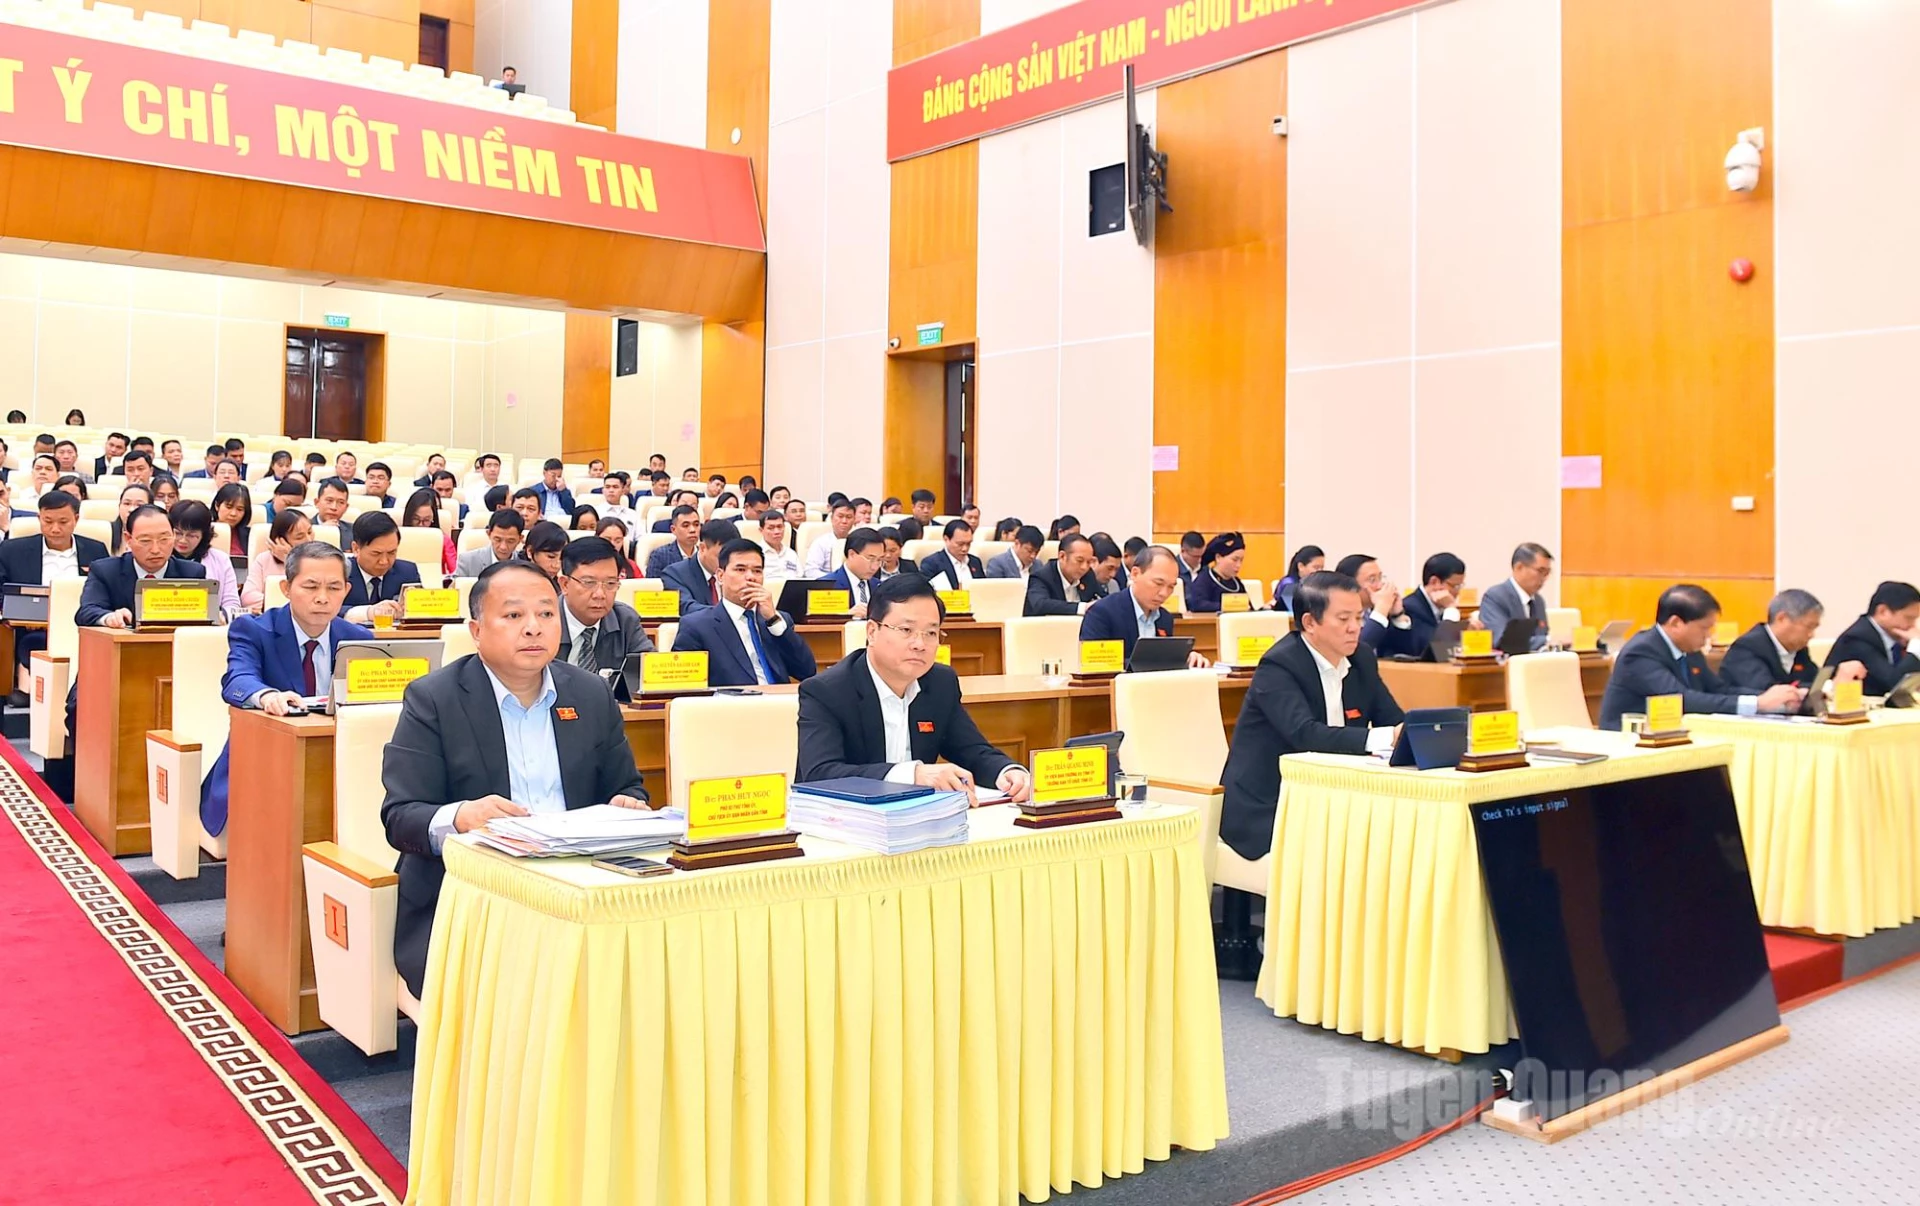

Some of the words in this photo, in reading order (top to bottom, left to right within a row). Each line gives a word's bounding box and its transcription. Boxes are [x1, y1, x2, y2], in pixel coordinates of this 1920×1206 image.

[923, 75, 965, 123] ĐẢNG
[969, 63, 1013, 112] CỘNG
[1017, 41, 1053, 92] SẢN
[1057, 30, 1096, 83] VIỆT
[1100, 17, 1146, 67] NAM
[51, 57, 93, 124] Ý
[122, 80, 250, 157] CHÍ,
[274, 104, 400, 179] MỘT
[421, 126, 562, 198] NIỀM
[575, 155, 658, 213] TIN
[1482, 809, 1503, 821] Check
[1524, 804, 1544, 814] input
[1547, 797, 1569, 811] signal
